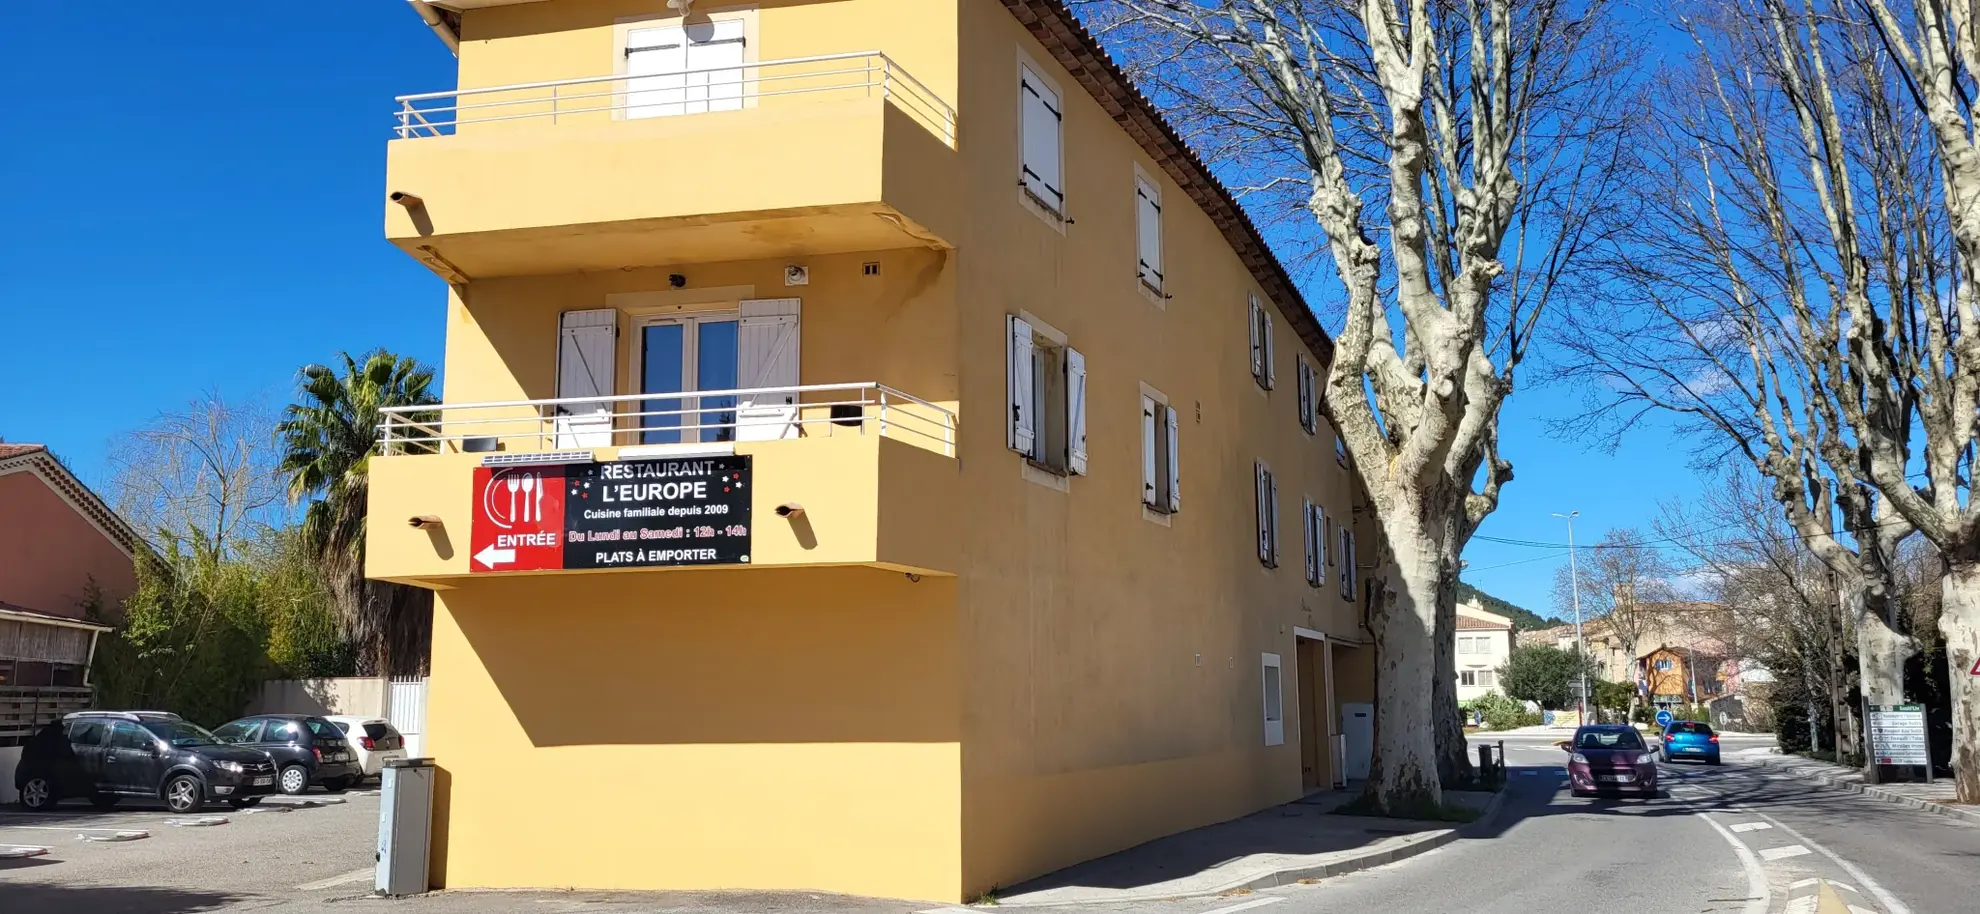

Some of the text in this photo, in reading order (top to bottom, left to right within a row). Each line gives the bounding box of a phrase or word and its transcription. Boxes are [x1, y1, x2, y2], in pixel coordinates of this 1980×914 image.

[600, 460, 715, 480] RESTAURANT
[602, 481, 707, 503] L'EUROPE
[583, 504, 729, 519] Cuisine familiale depuis 2009
[497, 531, 556, 548] ENTRÉE
[568, 530, 585, 542] Du
[587, 528, 621, 541] Lundi
[622, 530, 638, 540] au
[639, 526, 683, 539] Samedi
[685, 528, 690, 538] :
[693, 525, 715, 538] 12h
[725, 524, 747, 537] 14h
[595, 548, 717, 563] PLATS À EMPORTER
